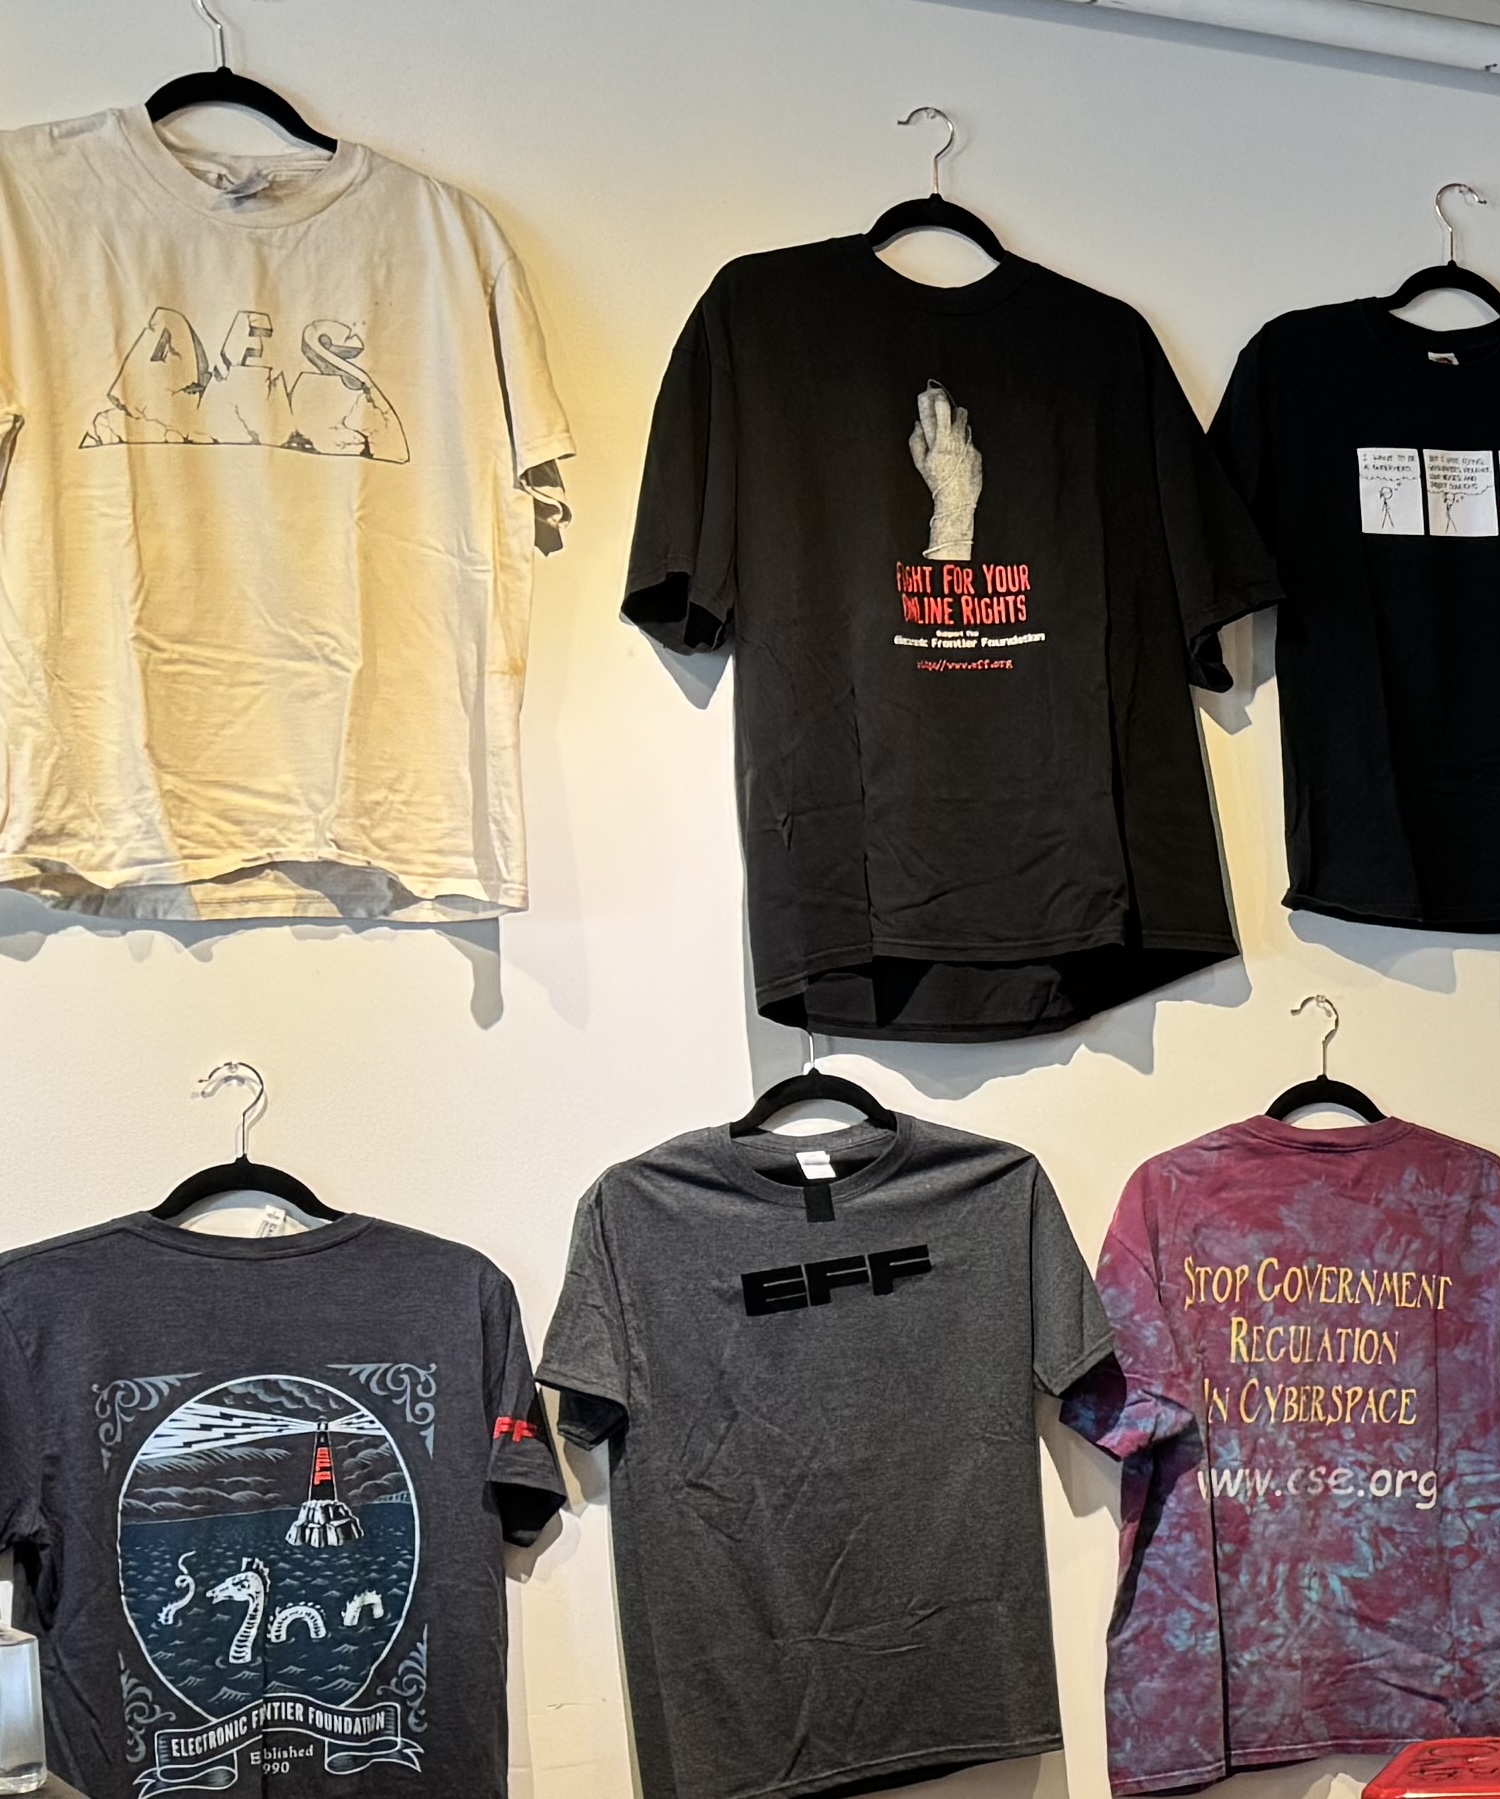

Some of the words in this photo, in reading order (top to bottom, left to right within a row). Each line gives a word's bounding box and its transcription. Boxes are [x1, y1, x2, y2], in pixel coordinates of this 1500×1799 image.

[943, 564, 975, 594] FOR
[982, 563, 1031, 593] YOUR
[961, 594, 1028, 625] RIGHTS
[931, 637, 978, 649] Frontier
[980, 632, 1046, 648] Foundation
[740, 1244, 933, 1317] EFF
[1183, 1254, 1250, 1312] STOP
[1256, 1256, 1453, 1311] GOVERNMENT
[1229, 1316, 1400, 1366] REGULATION
[1239, 1376, 1417, 1426] CYBERSPACE
[170, 1715, 248, 1758] ELECTRONIC
[251, 1701, 304, 1730] FNTIER
[250, 1744, 315, 1766] Eblished
[262, 1760, 290, 1775] 990
